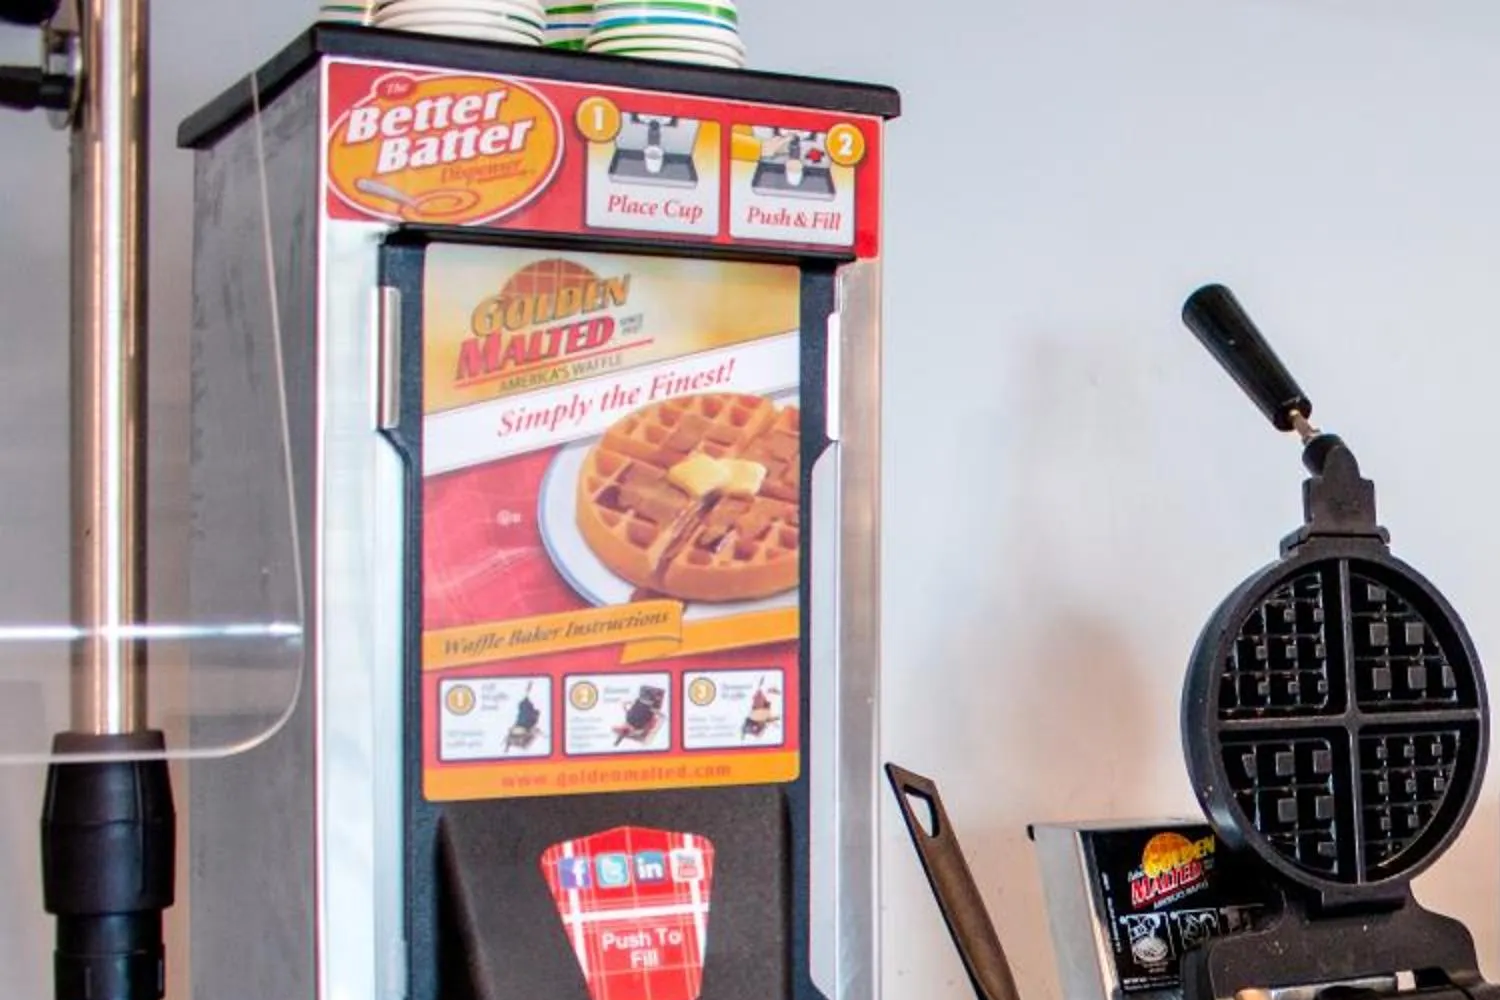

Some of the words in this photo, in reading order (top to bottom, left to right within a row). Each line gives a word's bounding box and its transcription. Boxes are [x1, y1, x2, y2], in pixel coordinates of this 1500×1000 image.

[346, 90, 507, 143] Better
[592, 106, 605, 130] 1
[377, 119, 533, 174] Batter
[838, 131, 853, 156] 2
[608, 194, 660, 219] Place
[665, 198, 704, 224] Cup
[747, 206, 790, 225] Push
[794, 212, 808, 227] &
[812, 210, 842, 230] Fill
[472, 273, 631, 337] GOLDEN
[456, 316, 615, 381] MALTED
[501, 366, 570, 391] AMERICA'S
[573, 357, 623, 376] WAFFLE
[498, 397, 593, 438] Simply
[600, 379, 639, 411] the
[648, 358, 736, 400] Finest!
[443, 634, 505, 657] Waffle
[510, 627, 561, 649] Baker
[565, 609, 669, 639] Instructions
[602, 929, 651, 951] Push
[656, 927, 682, 945] To
[631, 951, 659, 968] Fill
